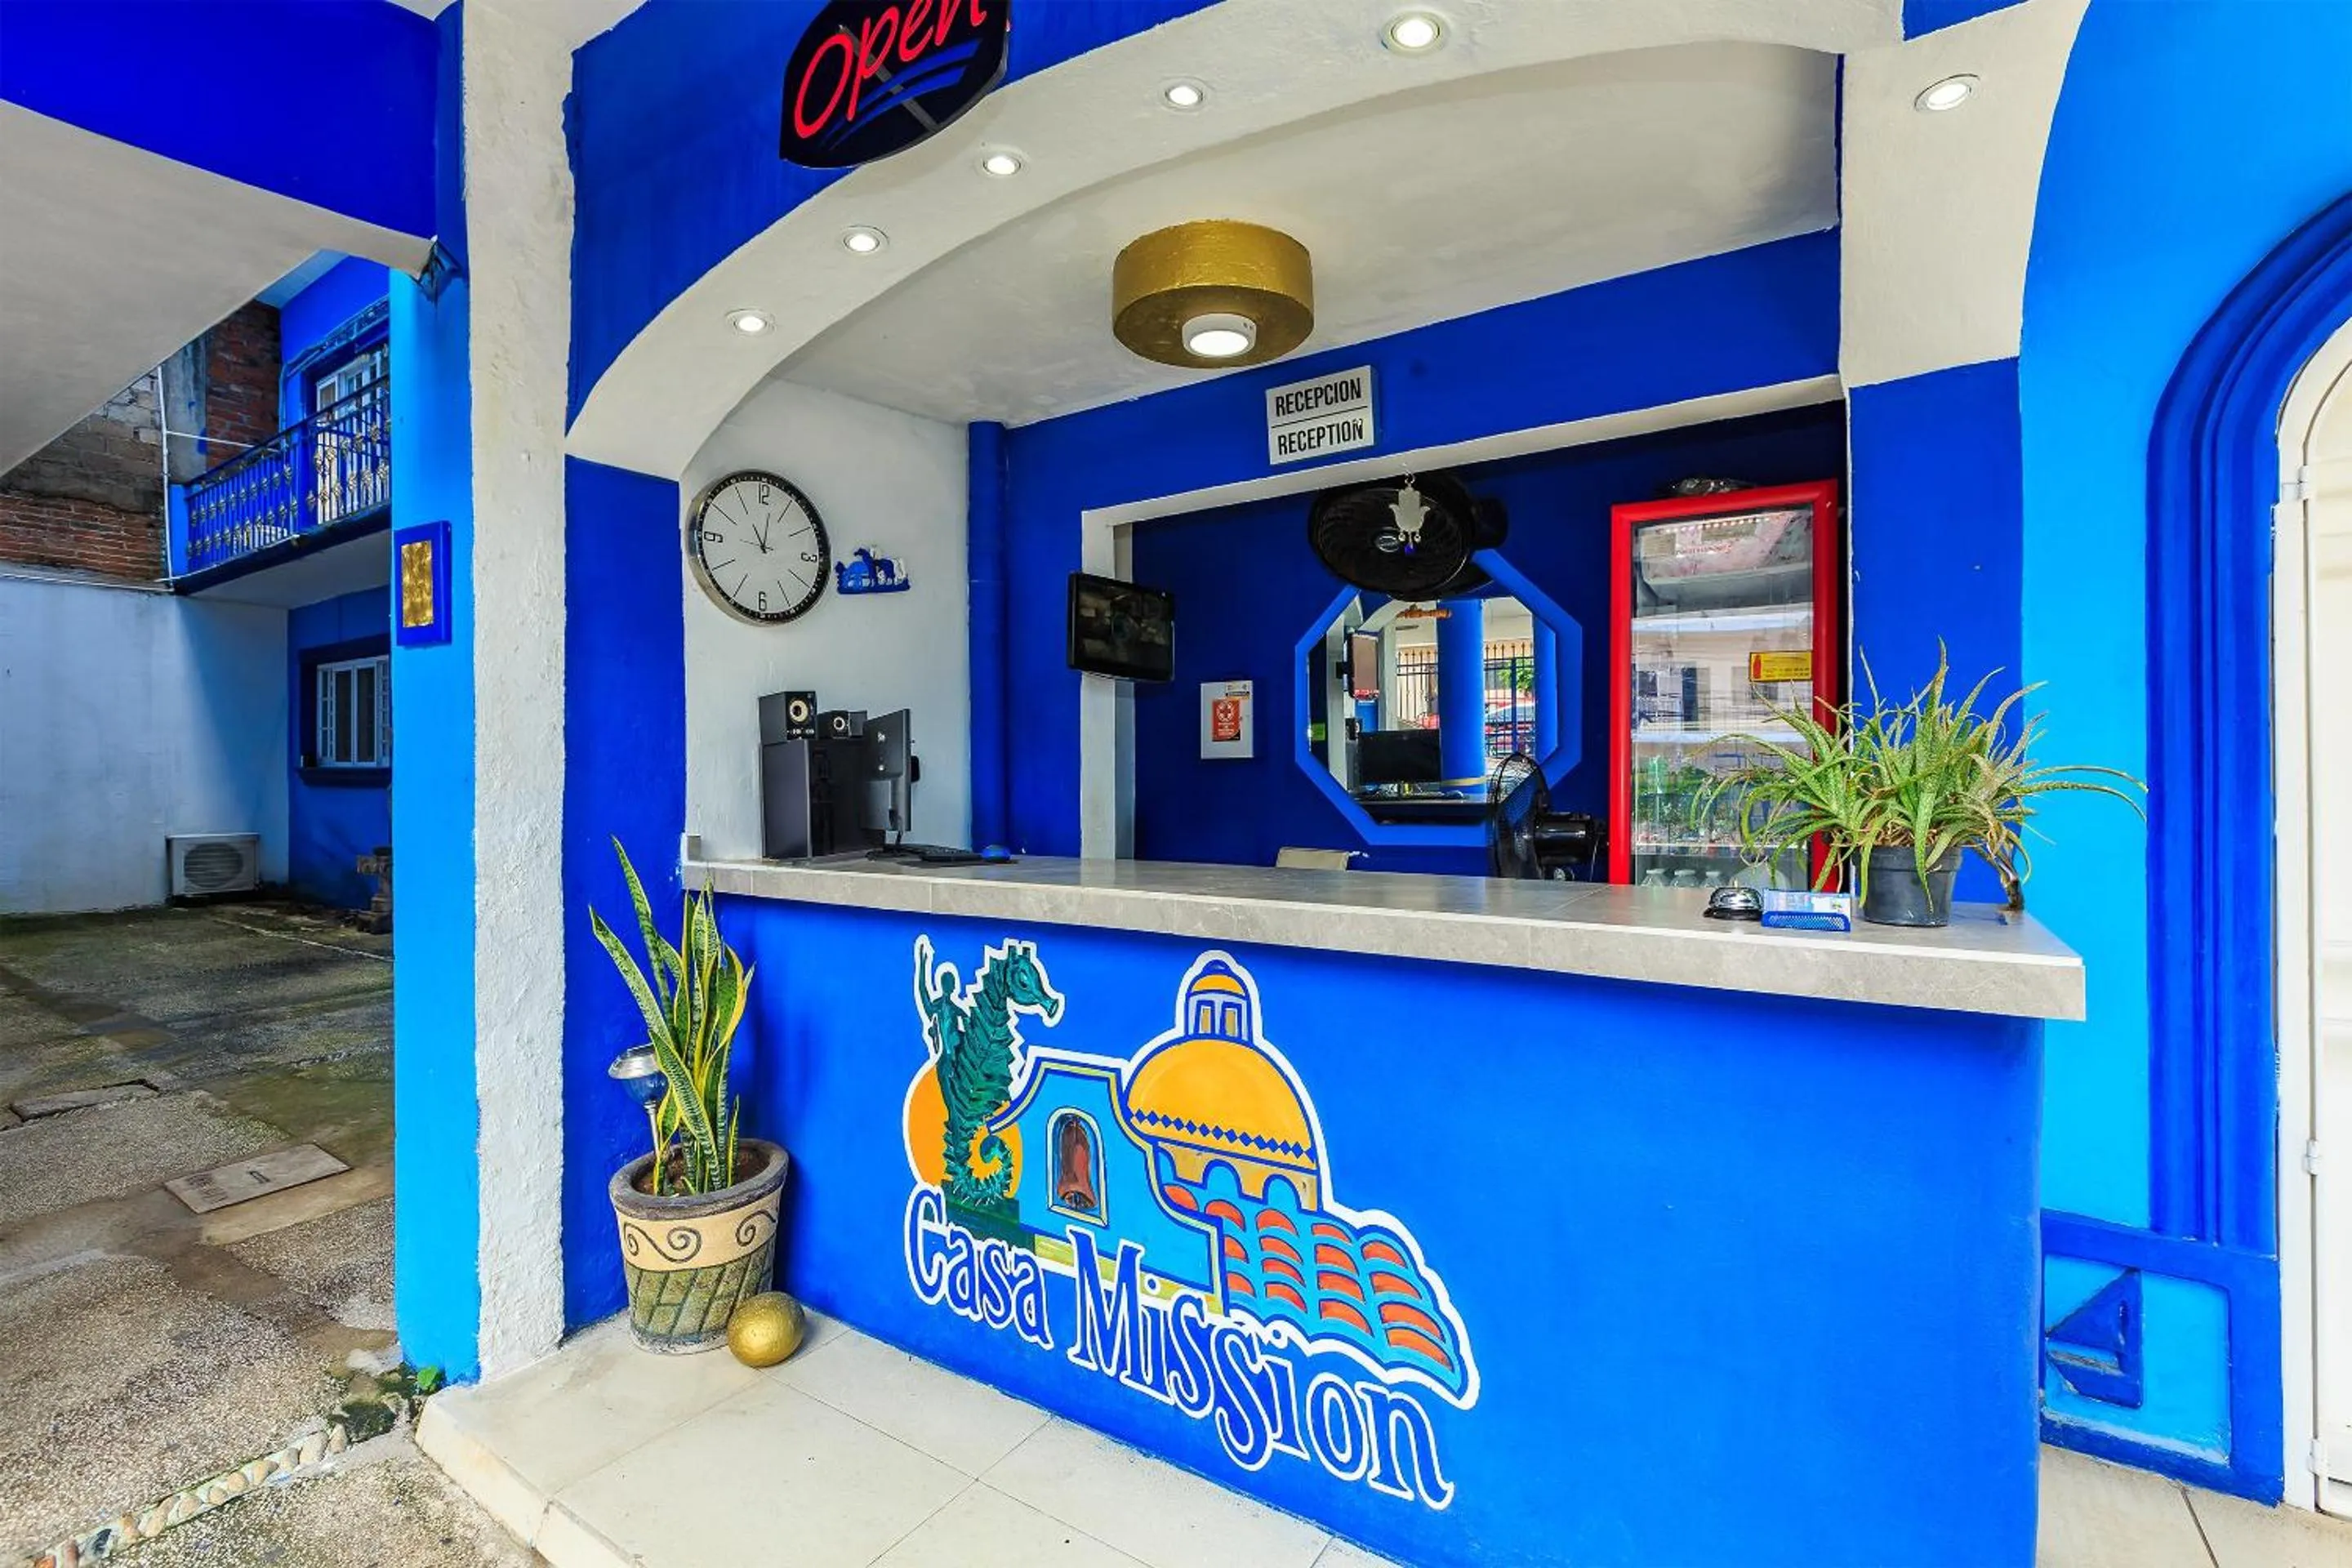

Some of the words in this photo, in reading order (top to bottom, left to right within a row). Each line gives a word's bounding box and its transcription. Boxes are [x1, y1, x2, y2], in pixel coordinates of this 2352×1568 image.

[1276, 377, 1361, 416] RECEPCION
[1278, 418, 1363, 456] RECEPTION
[758, 483, 770, 506] 12
[703, 531, 724, 543] 9
[800, 552, 817, 564] 3
[758, 590, 768, 612] 6
[905, 1187, 1054, 1349] Casa
[1066, 1225, 1454, 1509] Mission
